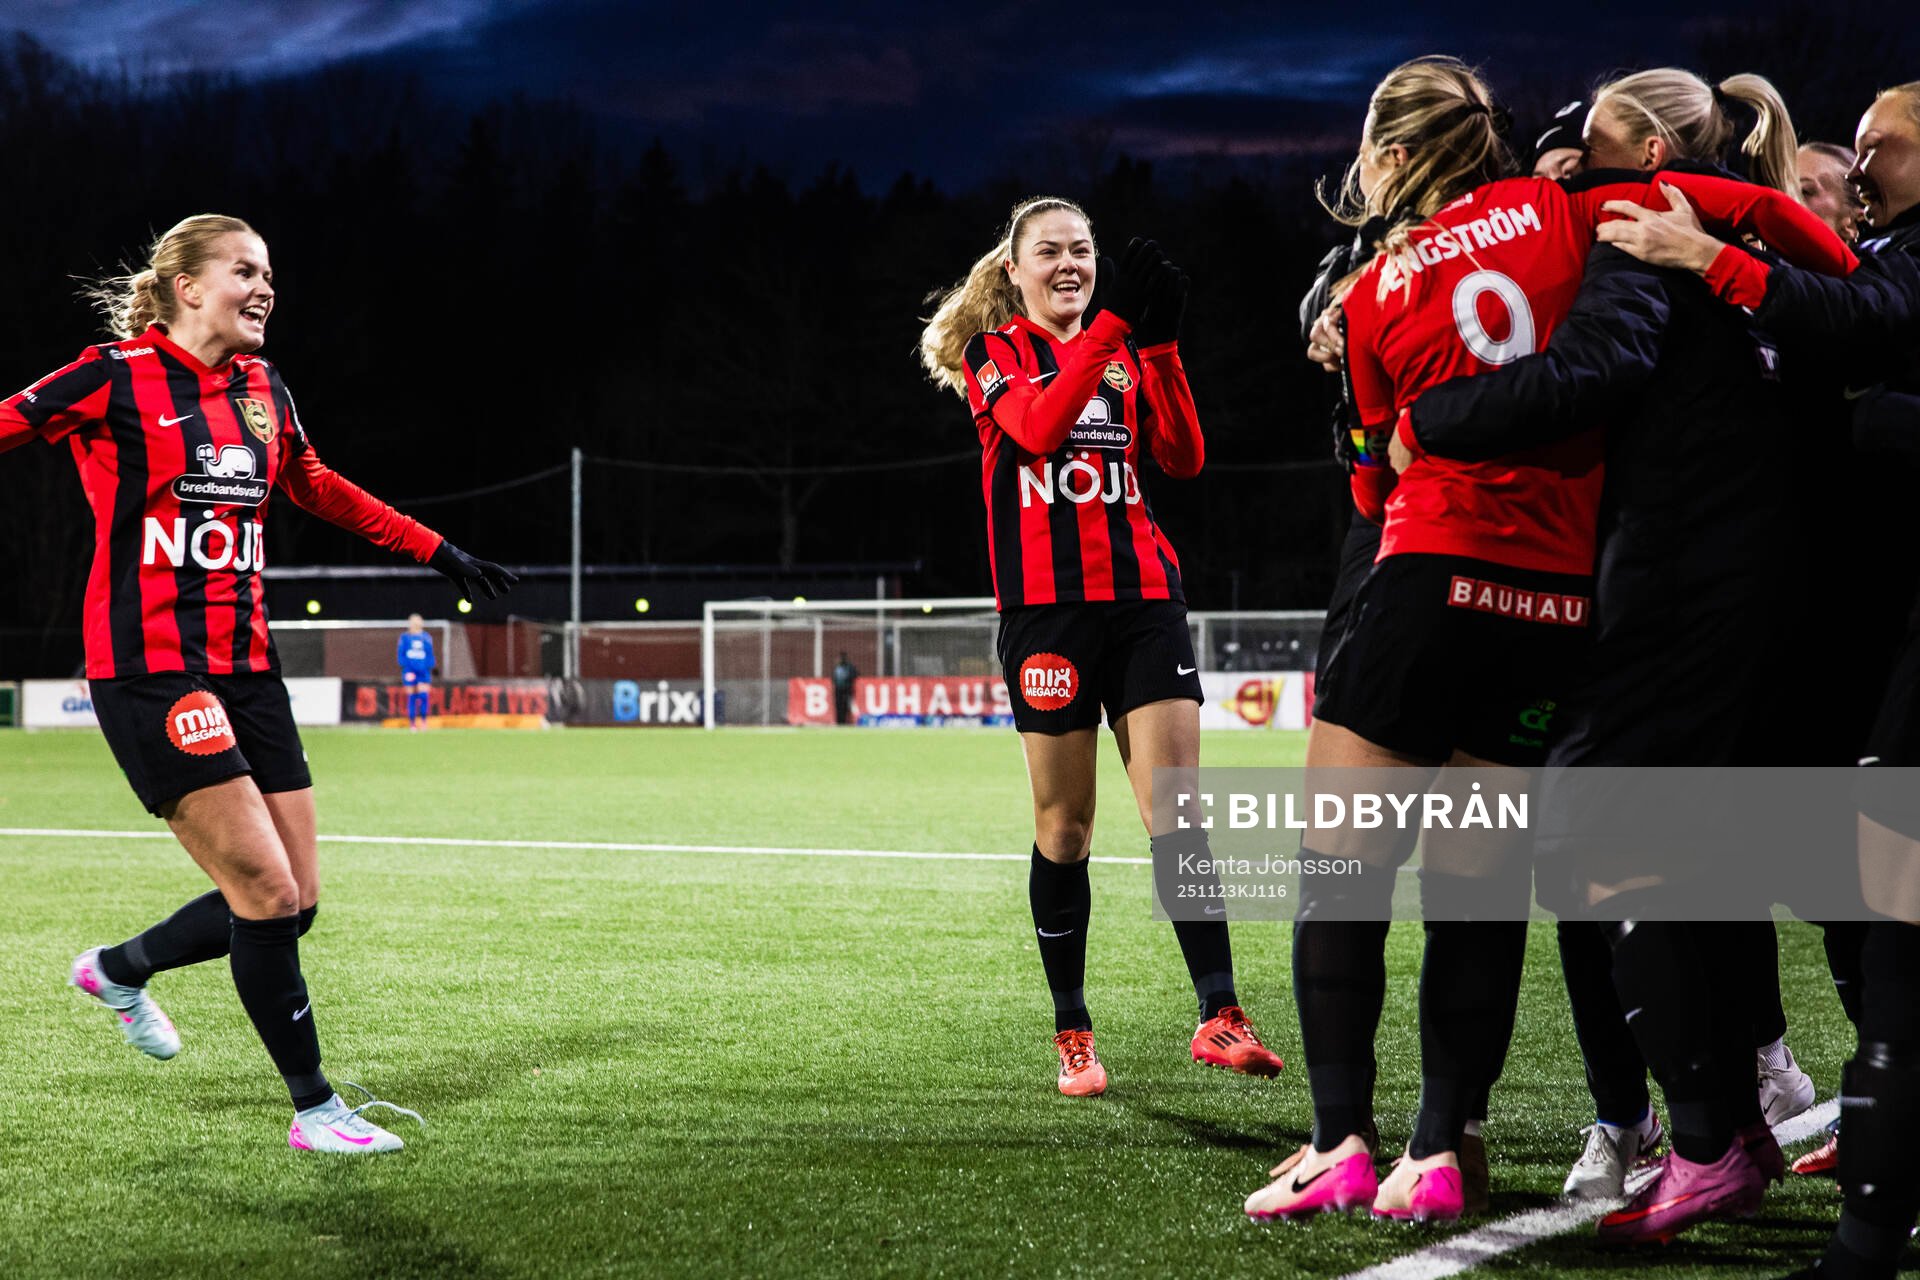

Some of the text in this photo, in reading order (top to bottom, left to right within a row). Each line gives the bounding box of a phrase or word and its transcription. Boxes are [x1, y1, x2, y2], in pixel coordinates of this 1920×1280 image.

[1452, 269, 1536, 365] 9
[1069, 428, 1128, 442] bandsval.se
[1019, 451, 1141, 508] NÖJD
[143, 509, 264, 571] NÖJD
[1453, 581, 1583, 622] BAUHAU
[805, 683, 1011, 717] BUHAUS
[1026, 687, 1070, 698] MEGAPOL
[181, 726, 235, 746] MEGAPO
